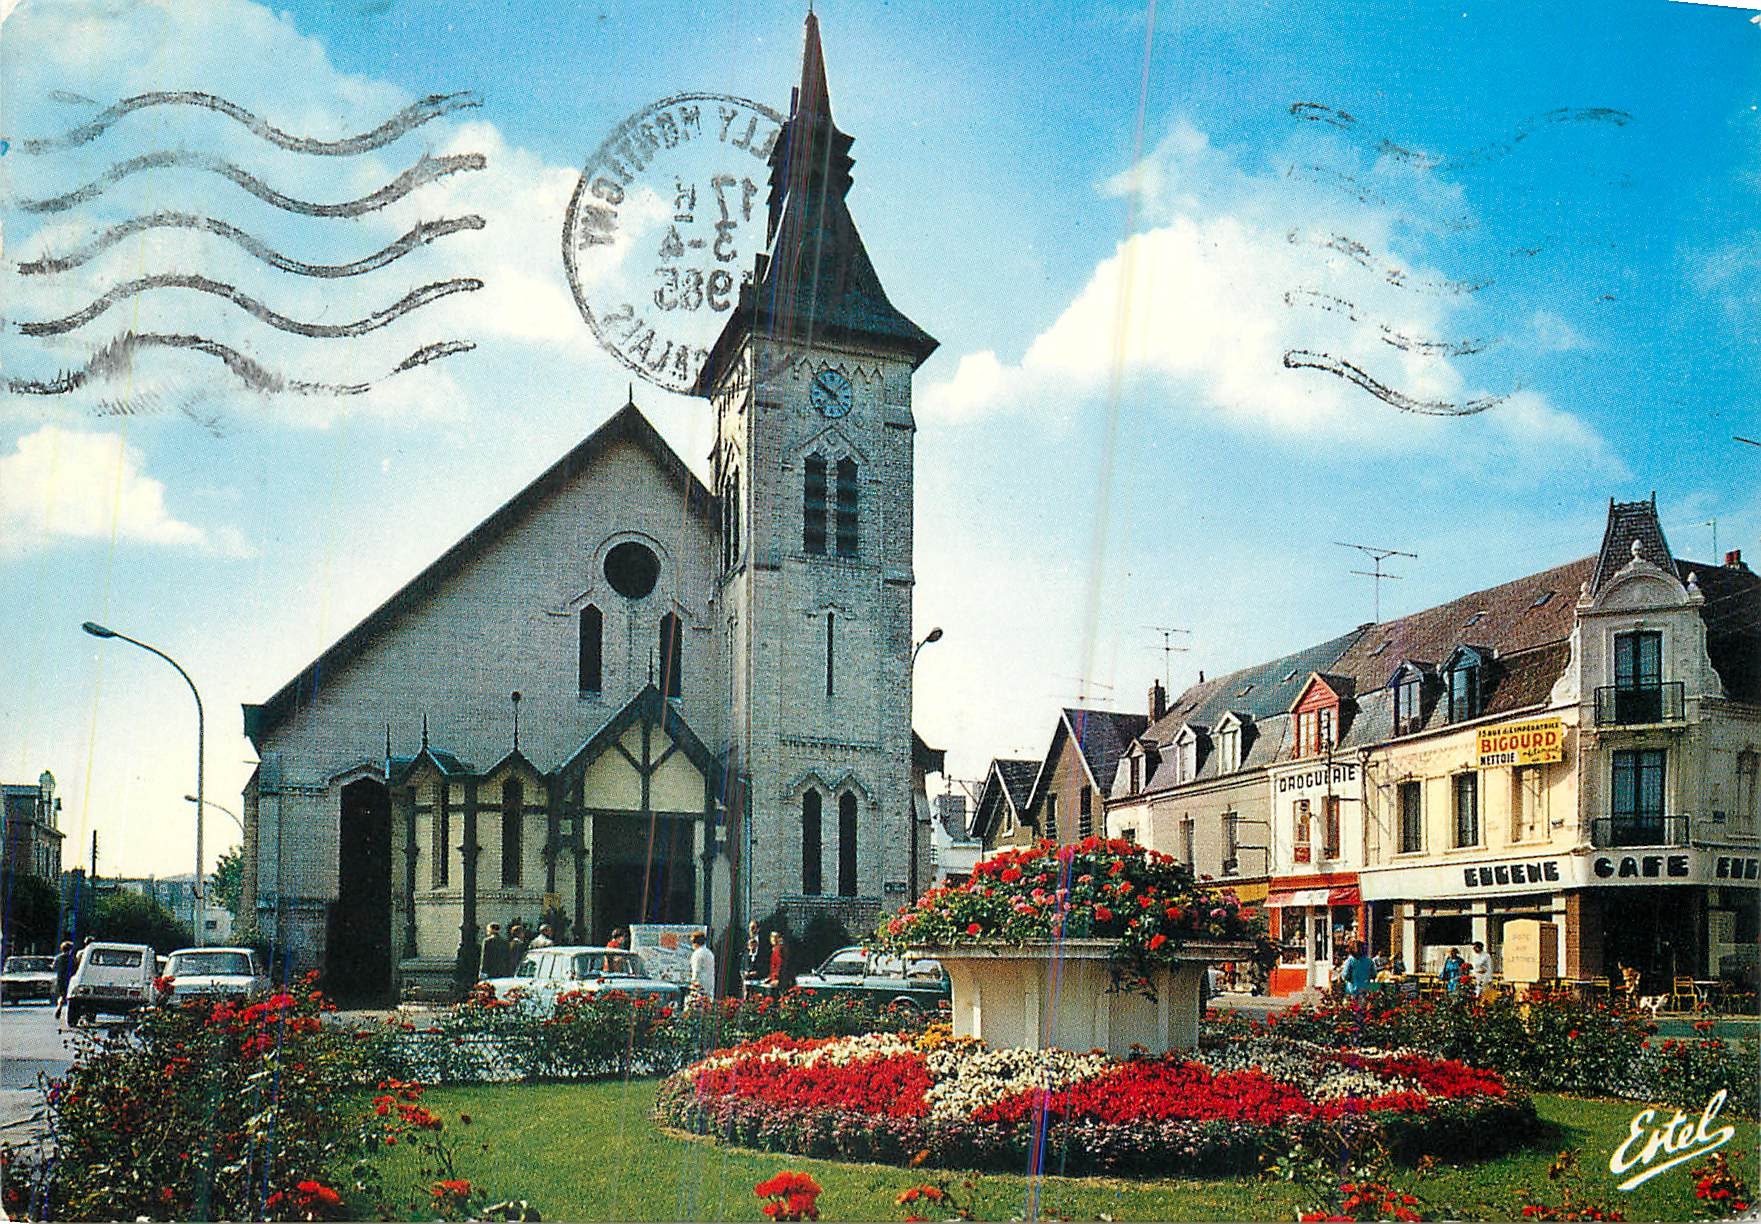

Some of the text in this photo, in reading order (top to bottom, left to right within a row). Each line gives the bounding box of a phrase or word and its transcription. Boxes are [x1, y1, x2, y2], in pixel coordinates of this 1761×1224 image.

[1481, 731, 1556, 753] BIGOURD
[1480, 752, 1515, 766] NETTOIE
[1279, 766, 1356, 793] DROGUERIE
[1463, 861, 1560, 887] EUGENE
